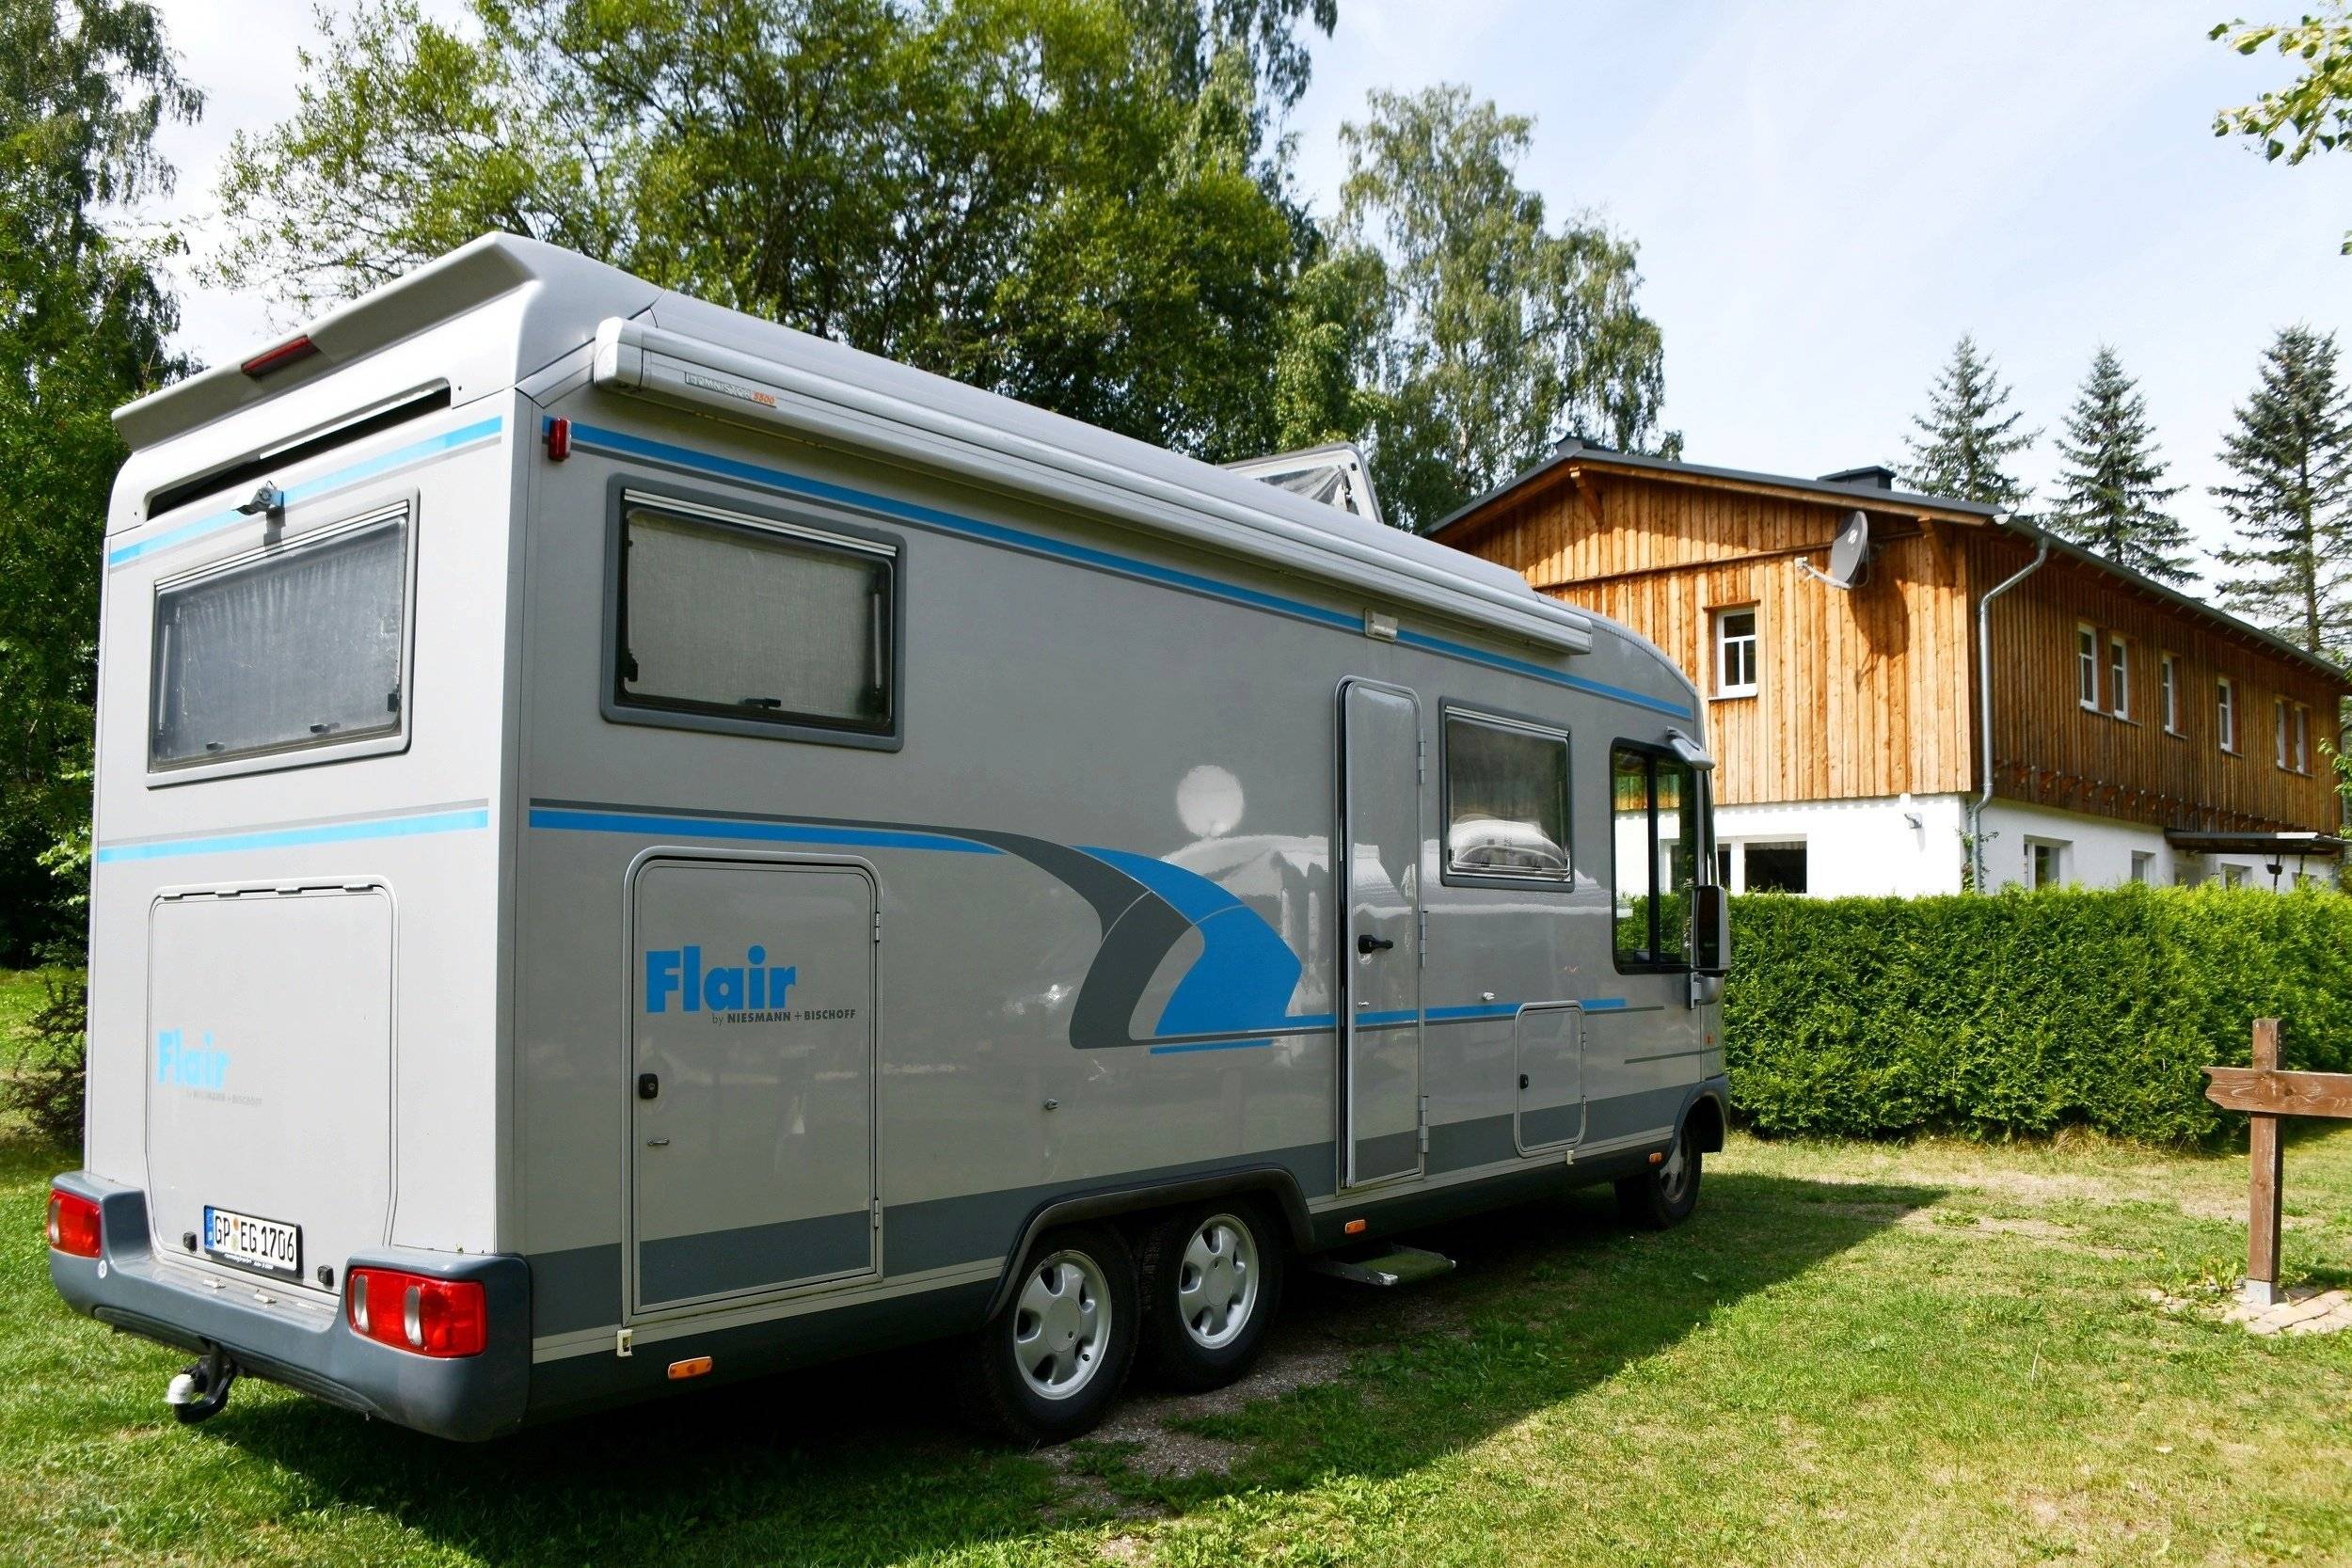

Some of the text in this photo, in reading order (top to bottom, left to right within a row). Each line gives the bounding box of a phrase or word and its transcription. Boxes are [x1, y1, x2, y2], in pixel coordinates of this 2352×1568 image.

[645, 944, 796, 1013] Flair
[712, 1012, 723, 1026] by
[727, 1011, 791, 1023] NIESMANN
[803, 1009, 856, 1022] BISCHOFF
[158, 1028, 230, 1091] Flair
[215, 1215, 230, 1245] GP
[241, 1221, 257, 1254] EG
[262, 1226, 294, 1262] 1706
